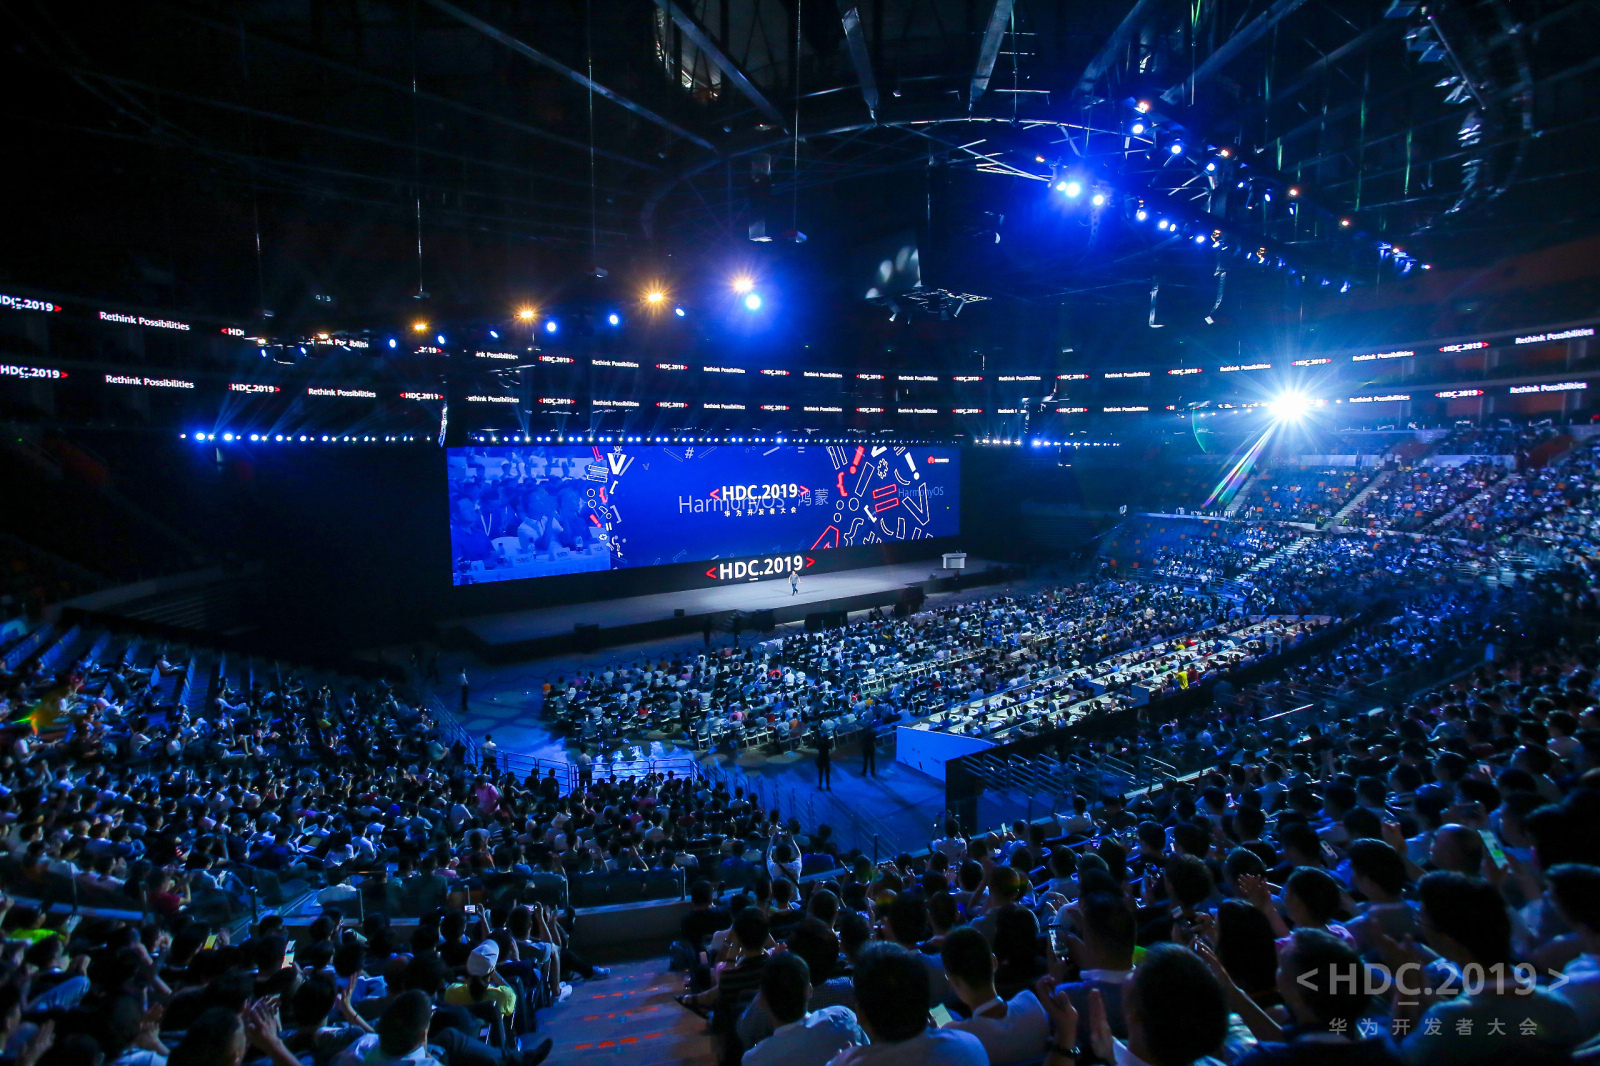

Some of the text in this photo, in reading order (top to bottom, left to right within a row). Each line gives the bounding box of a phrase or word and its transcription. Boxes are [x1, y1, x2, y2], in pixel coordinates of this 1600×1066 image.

[98, 310, 190, 331] Rethink Possibilities
[1514, 328, 1595, 345] Rethink Possibilities
[104, 374, 194, 389] Rethink Possibilities
[1509, 381, 1587, 394] Rethink Possibilities
[307, 387, 376, 399] Rethink Possibilities
